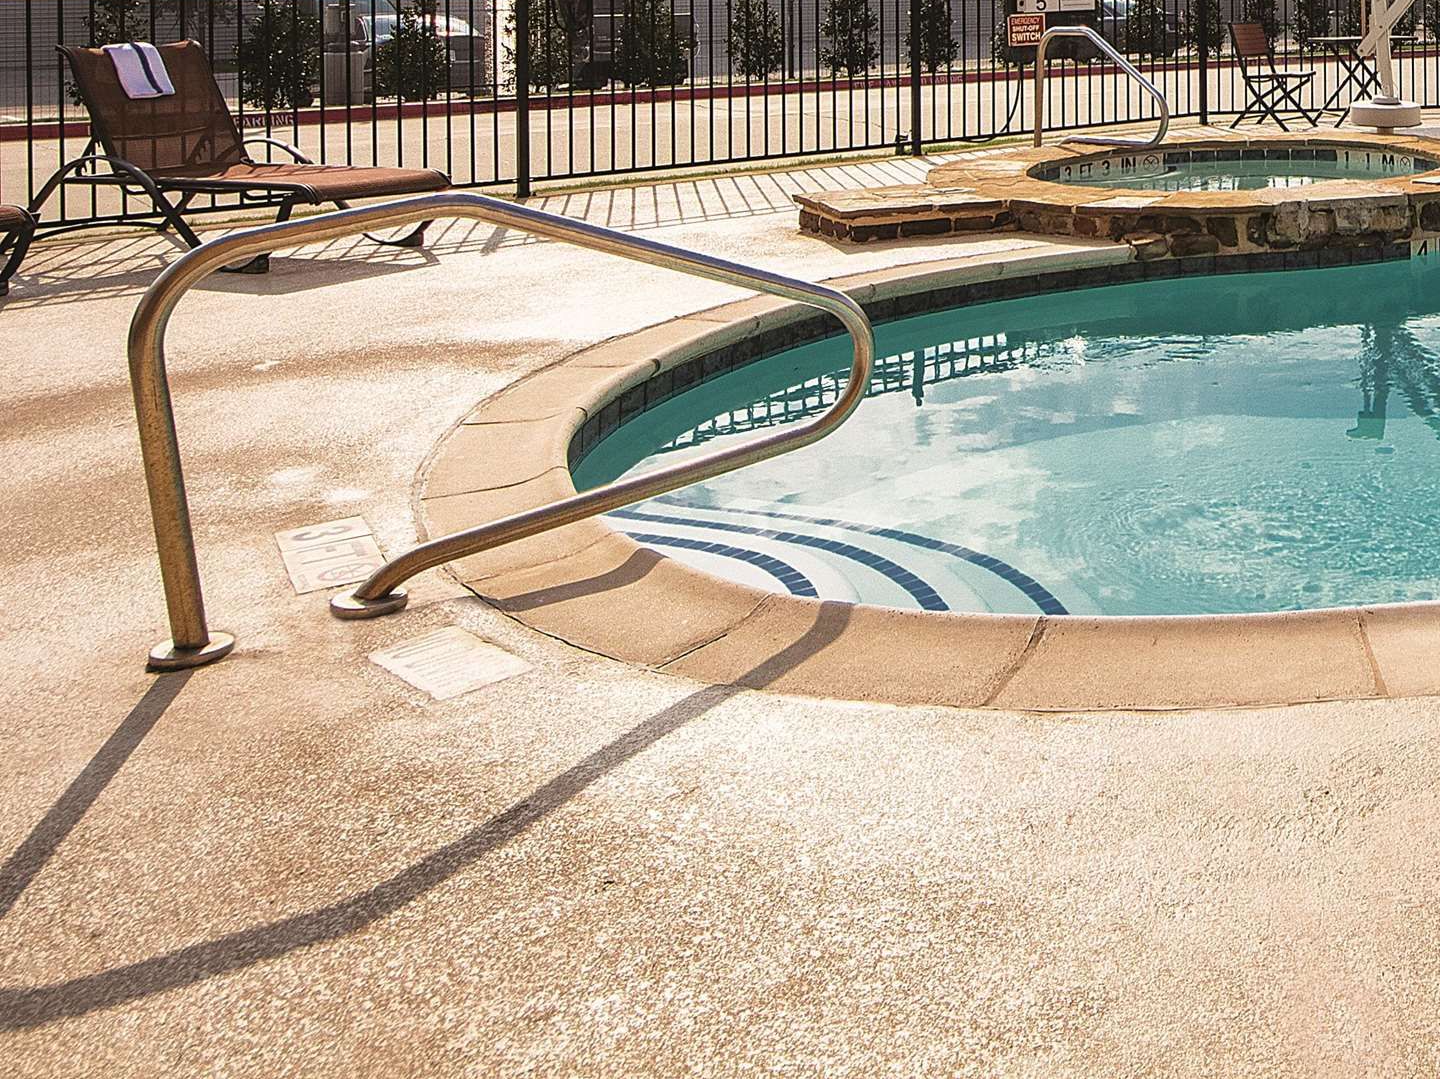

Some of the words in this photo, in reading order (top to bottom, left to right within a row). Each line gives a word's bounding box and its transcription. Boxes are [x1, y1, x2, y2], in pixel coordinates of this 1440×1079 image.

[1011, 17, 1040, 25] EMERGENCY
[1011, 31, 1041, 42] SWITCH
[1101, 160, 1110, 175] 3
[1121, 157, 1136, 172] IN
